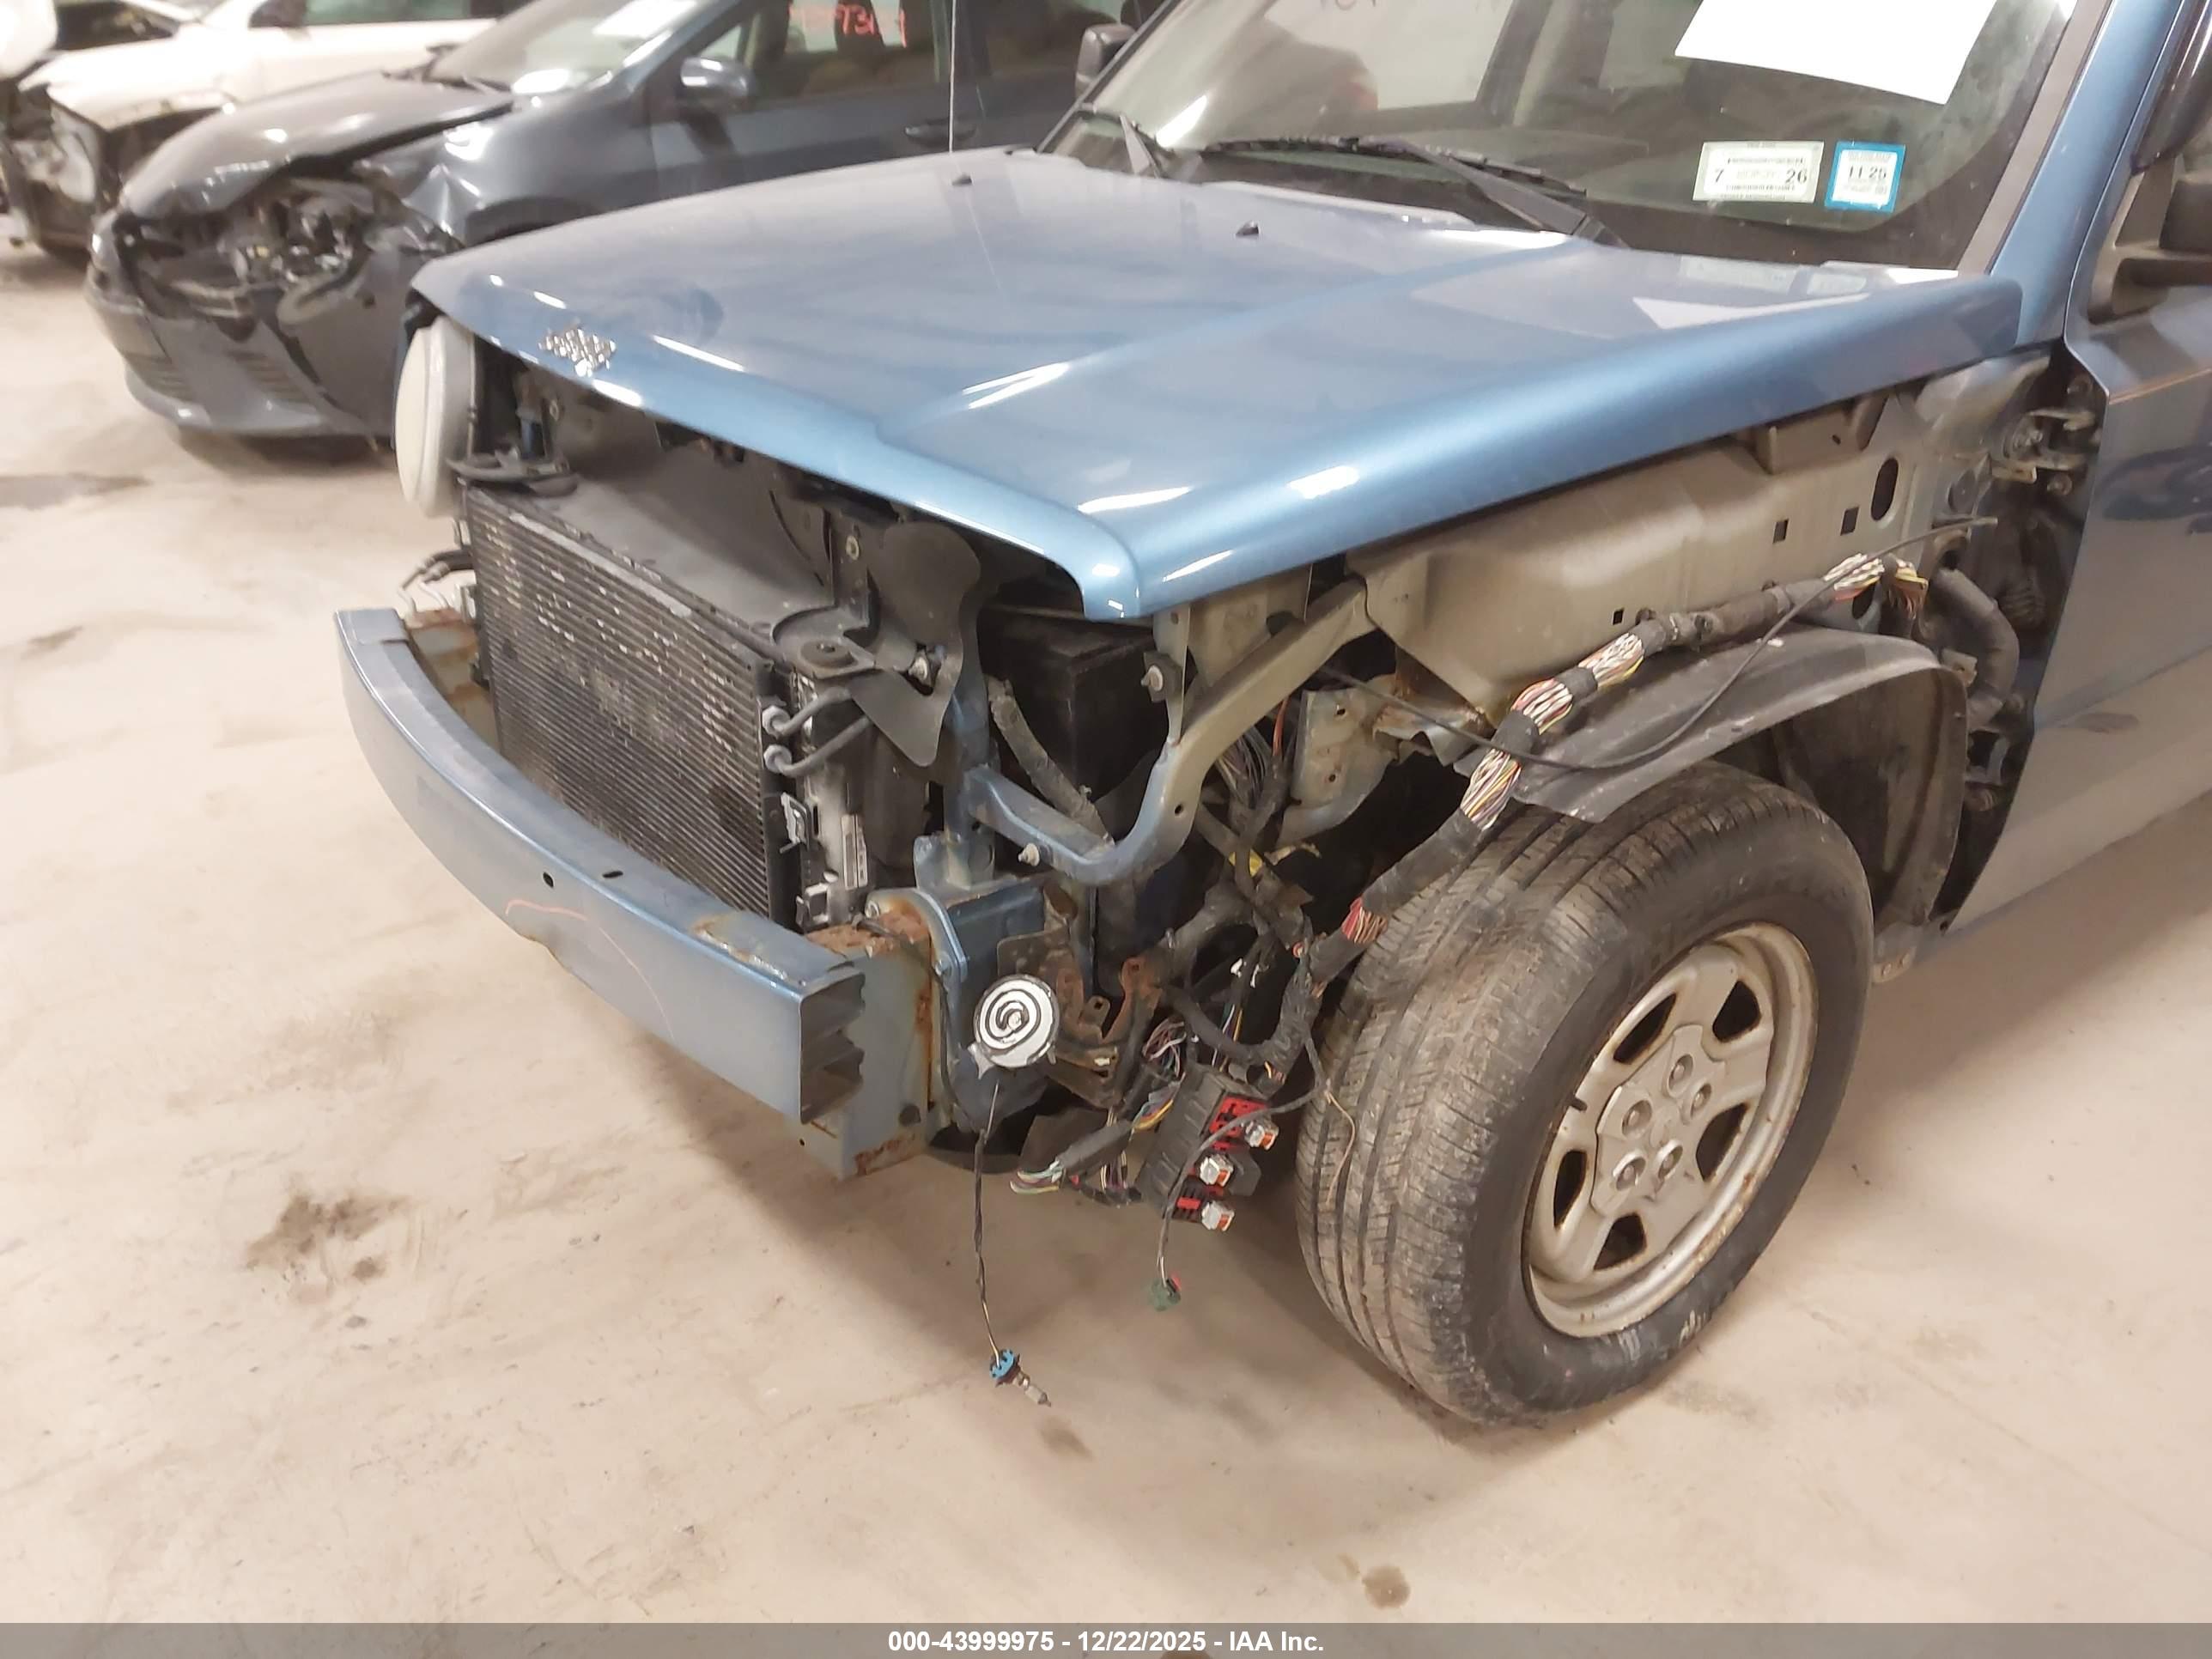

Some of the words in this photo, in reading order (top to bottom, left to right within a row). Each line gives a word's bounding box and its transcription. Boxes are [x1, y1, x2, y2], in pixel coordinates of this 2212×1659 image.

[1715, 168, 1725, 183] 7
[1784, 168, 1808, 184] 26
[1849, 165, 1863, 179] 11
